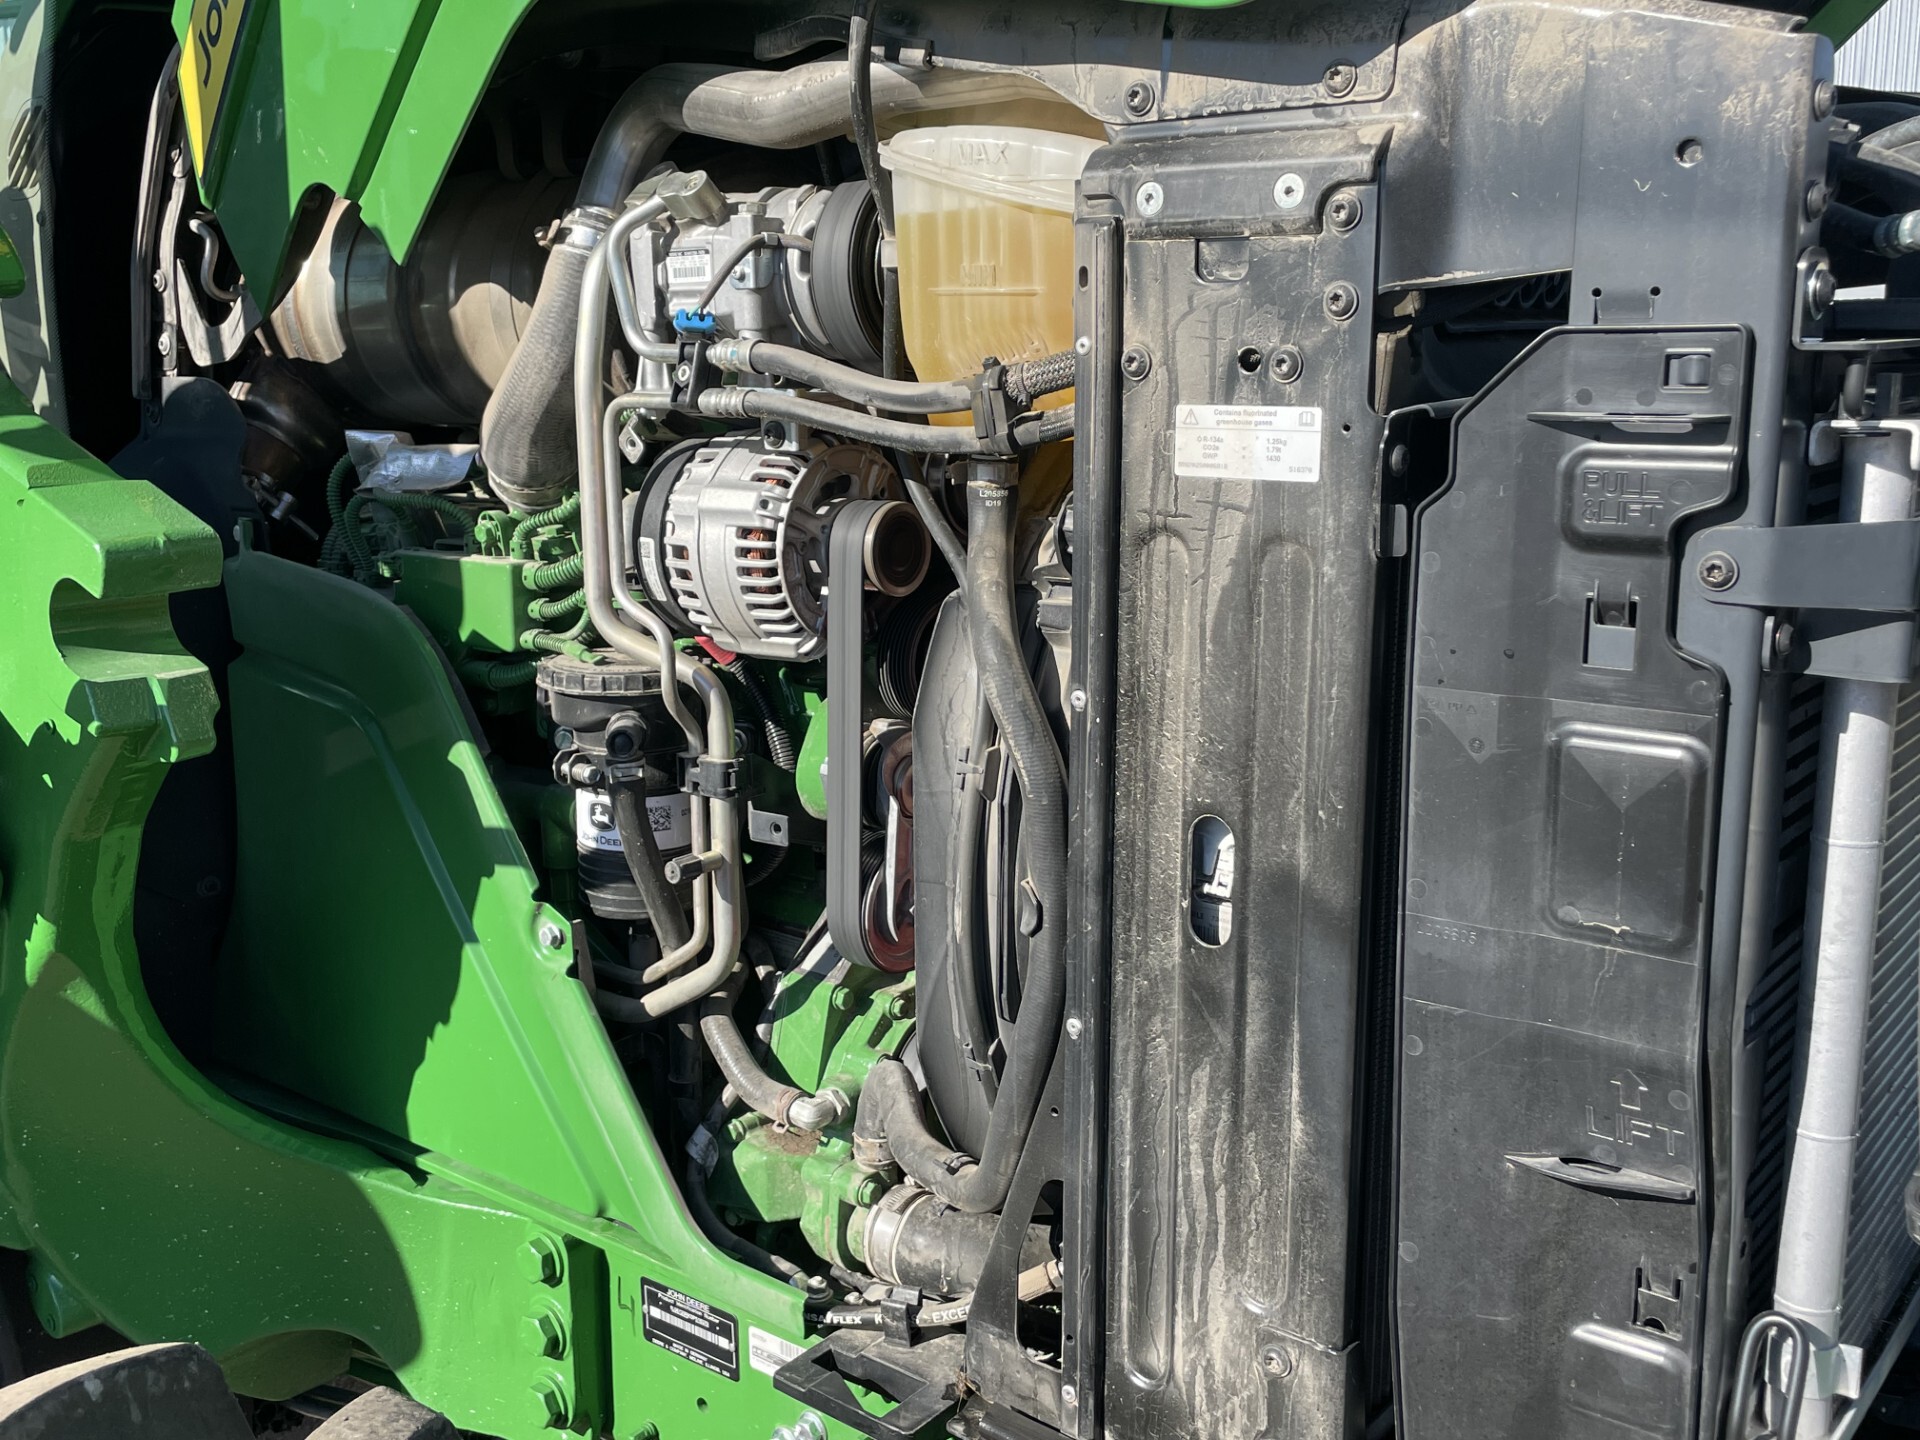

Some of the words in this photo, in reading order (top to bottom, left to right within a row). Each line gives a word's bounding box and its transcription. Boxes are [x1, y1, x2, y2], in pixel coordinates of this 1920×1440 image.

[198, 0, 229, 89] JO
[958, 142, 1010, 166] MAX
[961, 264, 997, 287] MIN
[1213, 408, 1242, 417] Contains
[1242, 409, 1278, 417] fluorinated
[1216, 418, 1253, 426] greenhouse
[1254, 419, 1273, 427] gases
[1583, 470, 1662, 498] PULL
[985, 499, 1002, 507] ID19
[1582, 498, 1665, 527] &LIFT
[1585, 1105, 1685, 1156] LIFT
[667, 1288, 686, 1303] JOHN
[686, 1297, 710, 1313] DEERE
[833, 1315, 862, 1325] FLEX
